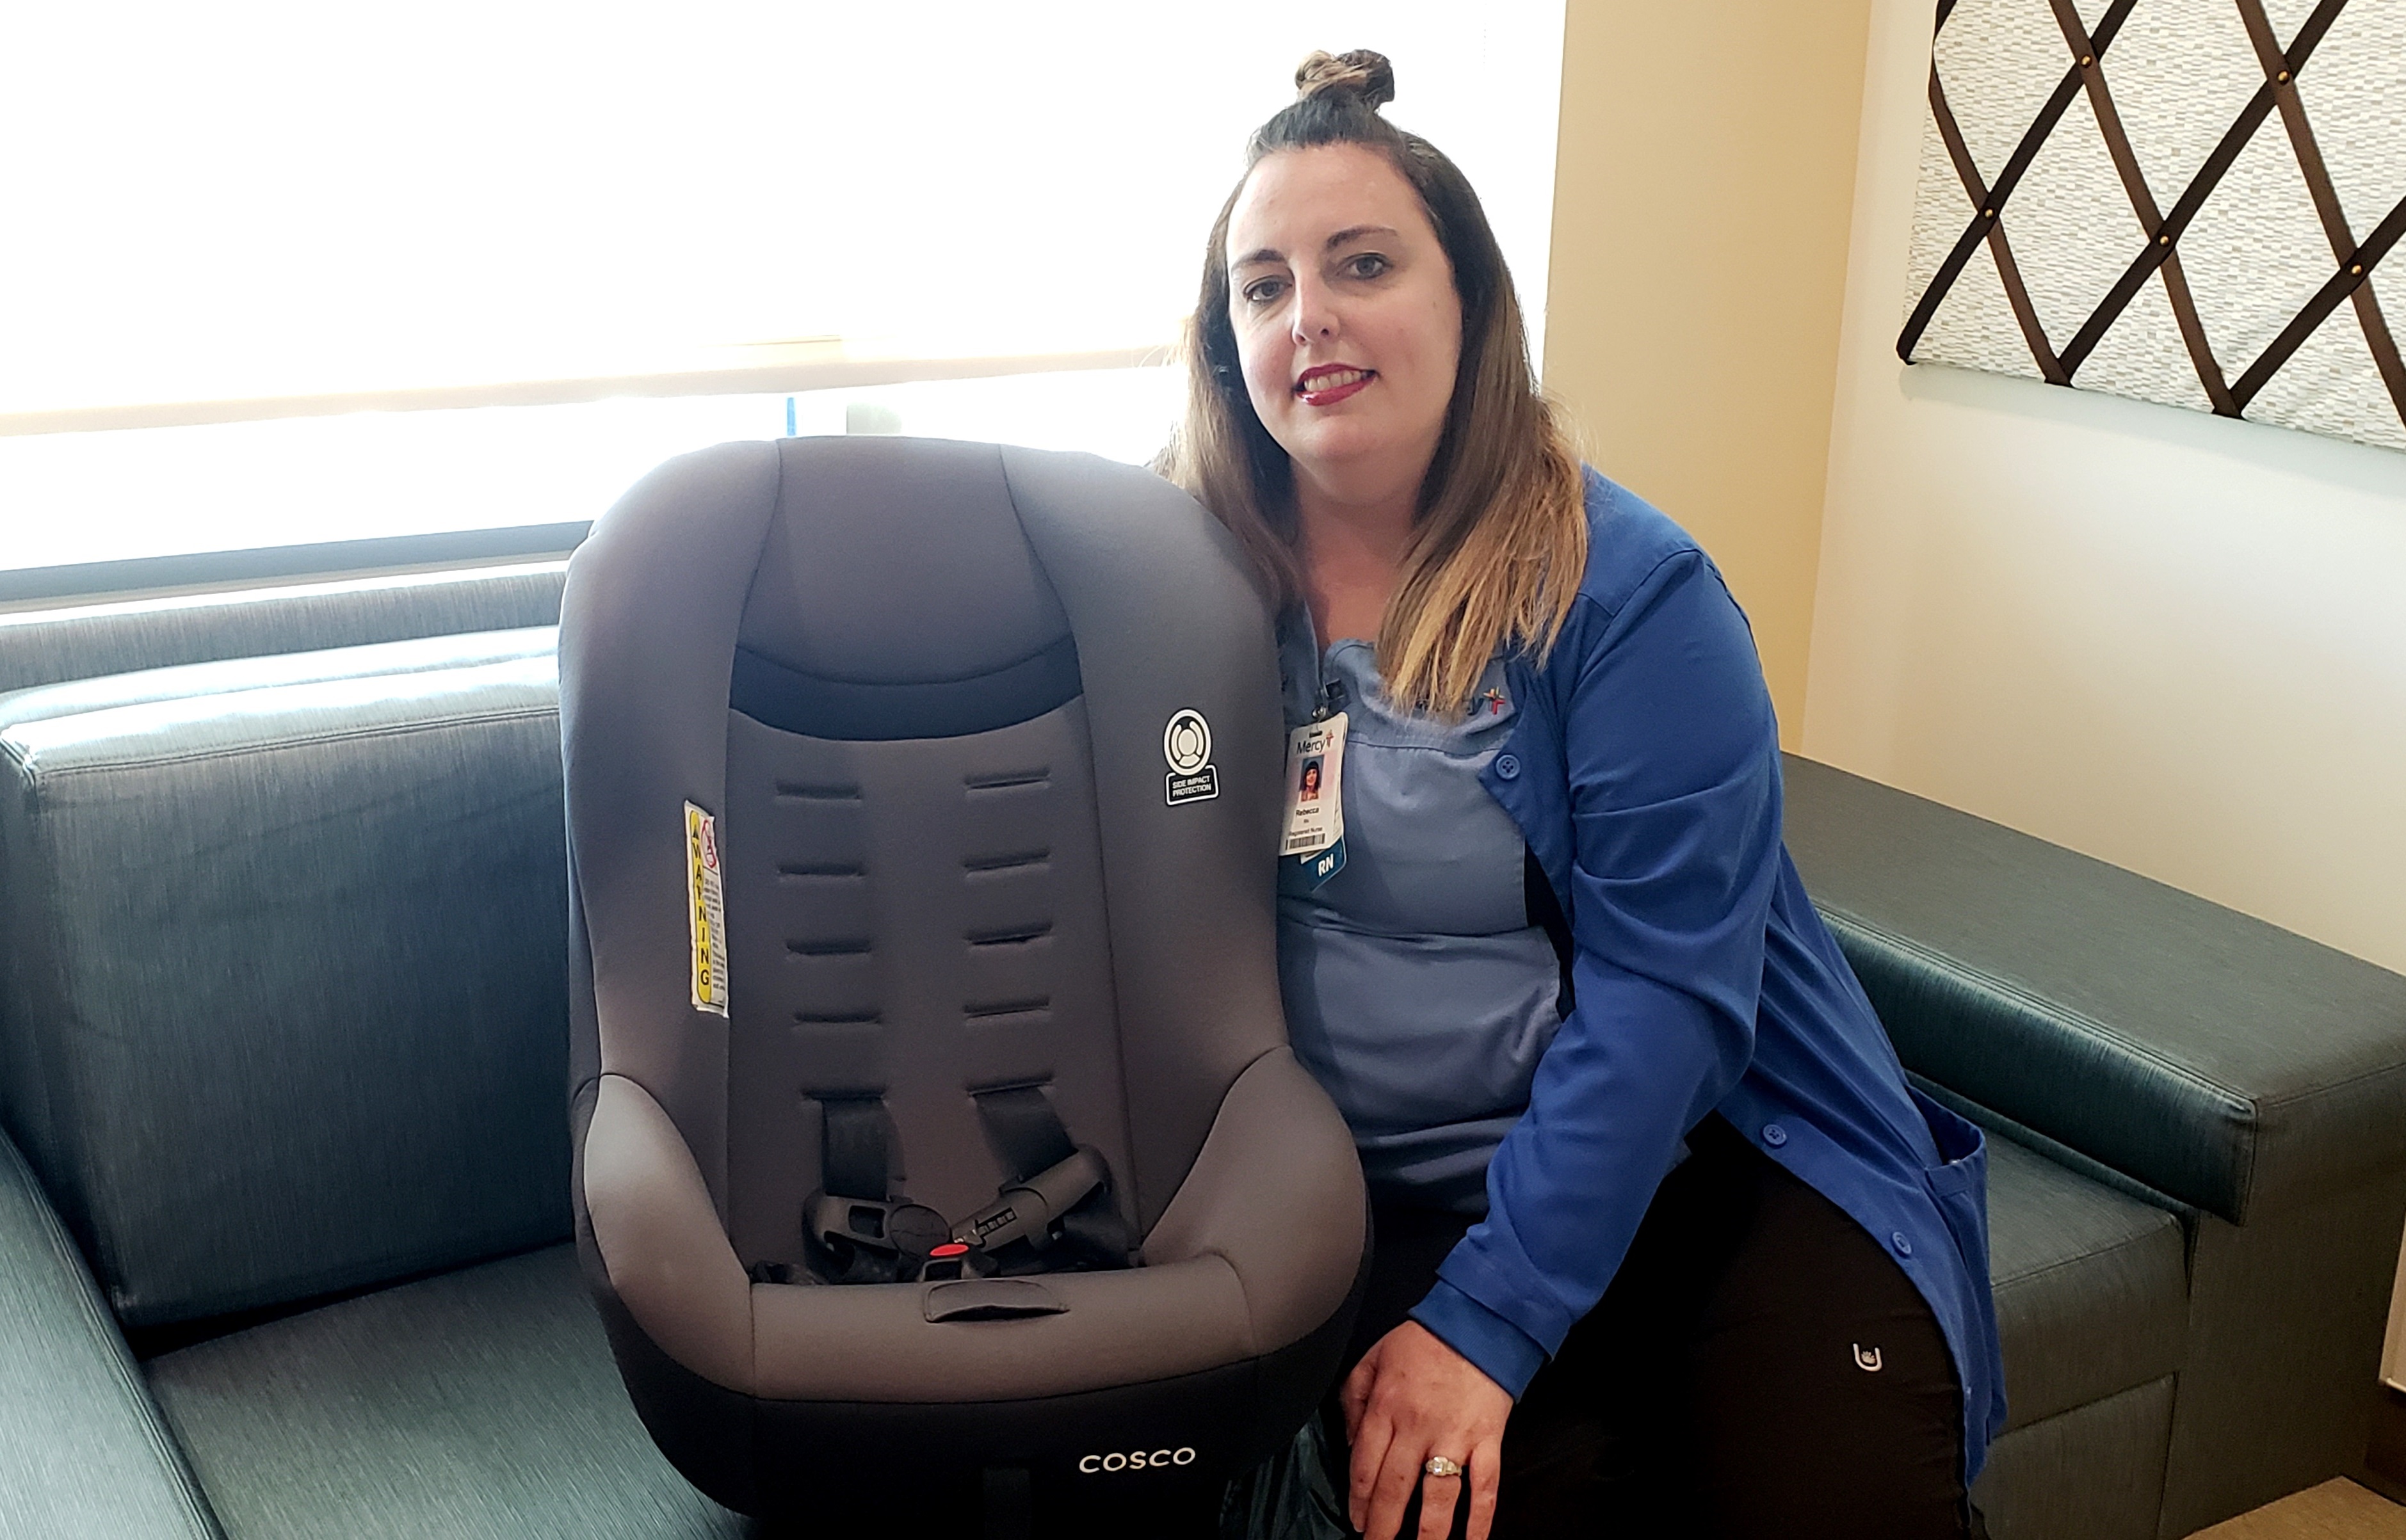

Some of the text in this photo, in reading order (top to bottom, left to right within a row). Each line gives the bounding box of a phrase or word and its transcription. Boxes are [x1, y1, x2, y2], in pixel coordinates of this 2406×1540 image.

[1296, 739, 1325, 754] Mercy
[1172, 775, 1210, 789] SIDE IMPACT
[1172, 783, 1211, 797] PROTECTION
[1318, 853, 1334, 877] RN
[1079, 1447, 1196, 1473] COSCO
